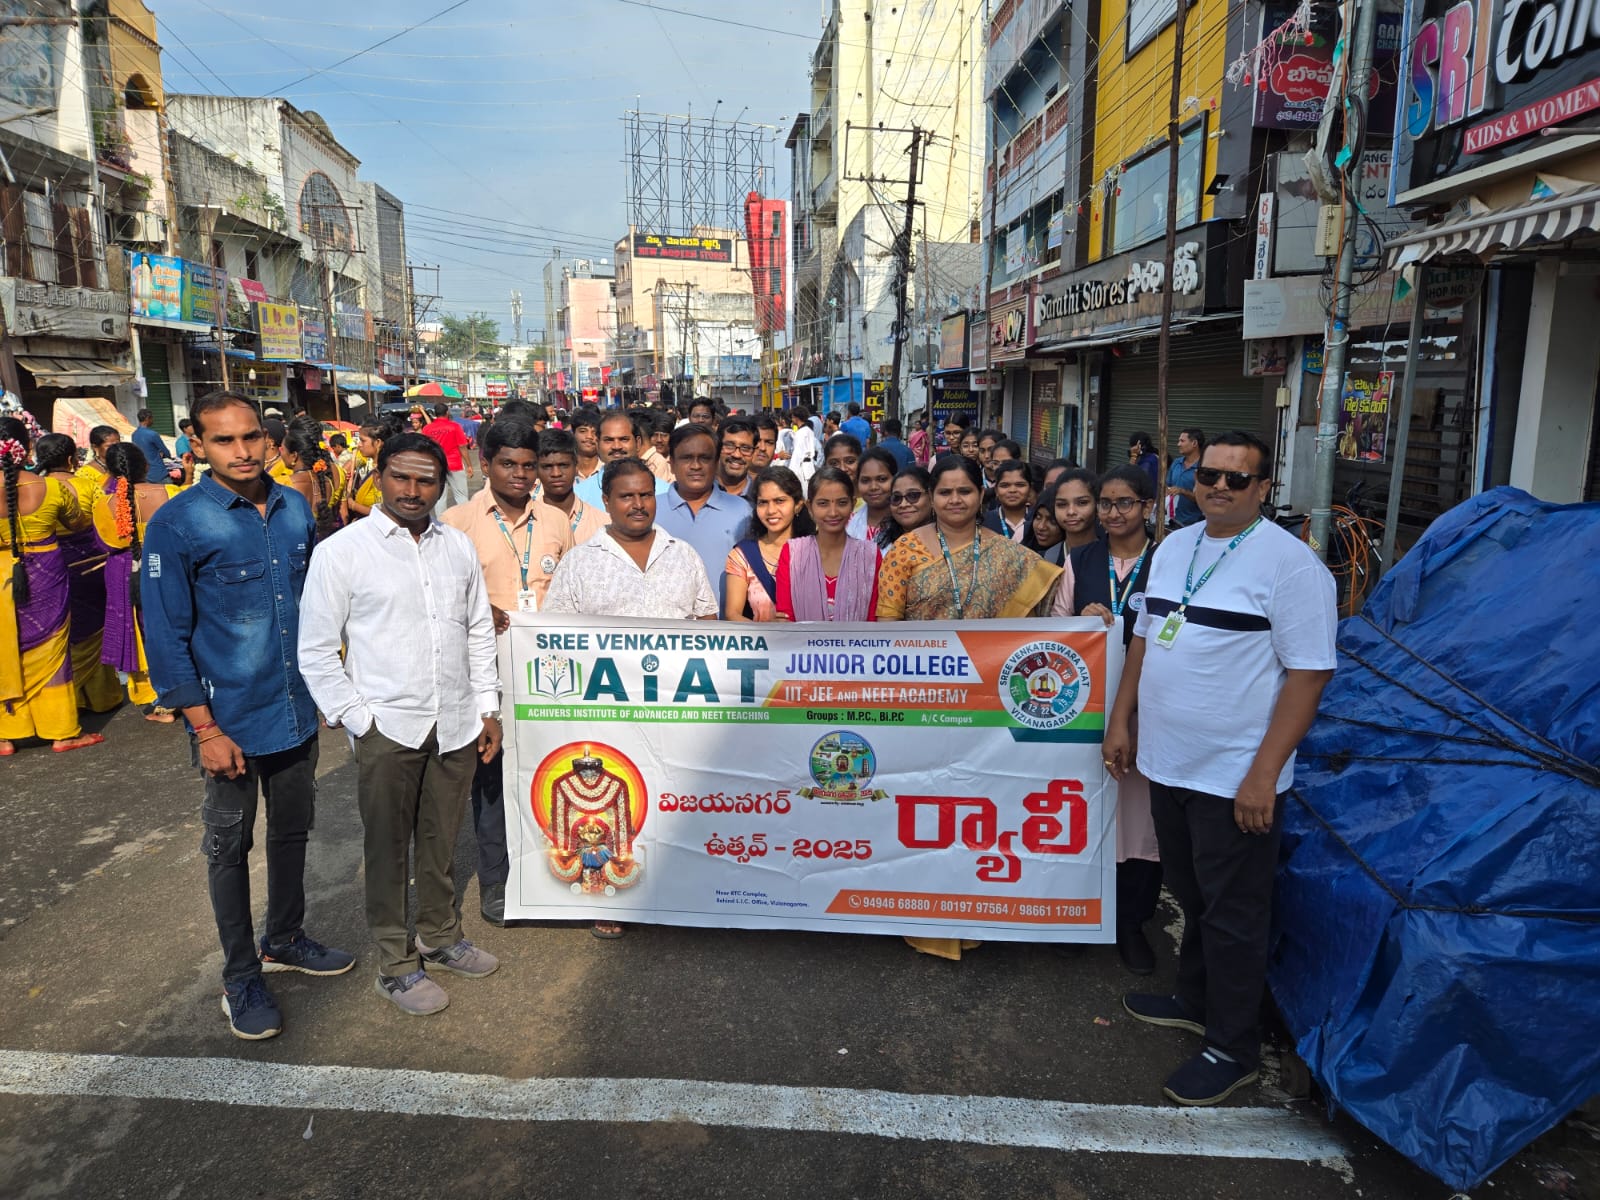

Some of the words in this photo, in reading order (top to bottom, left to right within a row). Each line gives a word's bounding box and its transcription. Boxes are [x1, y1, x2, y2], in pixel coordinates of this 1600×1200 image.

[1407, 0, 1493, 140] SRI
[1496, 0, 1600, 83] Coll
[1466, 122, 1503, 152] KIDS
[1506, 115, 1519, 137] &
[1040, 284, 1080, 321] Sarathi
[1082, 279, 1125, 311] Stores
[933, 400, 976, 409] Accessories
[943, 390, 968, 400] Mobile
[536, 633, 589, 650] SREE
[596, 634, 768, 651] VENKATESWARA
[808, 639, 847, 648] HOSTEL
[849, 639, 892, 648] FACILITY
[893, 639, 948, 648] AVAILABLE
[785, 654, 865, 675] JUNIOR
[873, 655, 969, 677] COLLEGE
[1000, 663, 1013, 686] SREE
[1009, 642, 1081, 665] VENKATESWARA
[785, 686, 833, 703] IIT-JEE
[837, 691, 857, 702] AND
[862, 687, 895, 703] NEET
[899, 688, 968, 704] ACADEMY
[528, 708, 571, 719] ACHIVERS
[573, 709, 617, 719] INSTITUTE
[619, 709, 631, 719] OF
[633, 710, 679, 720] ADVANCED
[681, 710, 699, 720] AND
[702, 710, 723, 721] NEET
[726, 711, 770, 722] TEACHING
[806, 710, 838, 722] Groups
[921, 713, 937, 724] A/C
[940, 714, 972, 725] Campus
[1011, 709, 1078, 728] VIZIANAGARAM
[658, 790, 792, 814] విజయనగర్
[895, 779, 1088, 883] ర్యాలీ
[793, 838, 872, 860] 2025
[863, 897, 894, 909] 94946
[898, 899, 930, 911] 68880
[940, 900, 972, 913] 80197
[976, 902, 1009, 914] 97564
[1019, 904, 1051, 916] 98661
[1055, 905, 1087, 917] 17801
